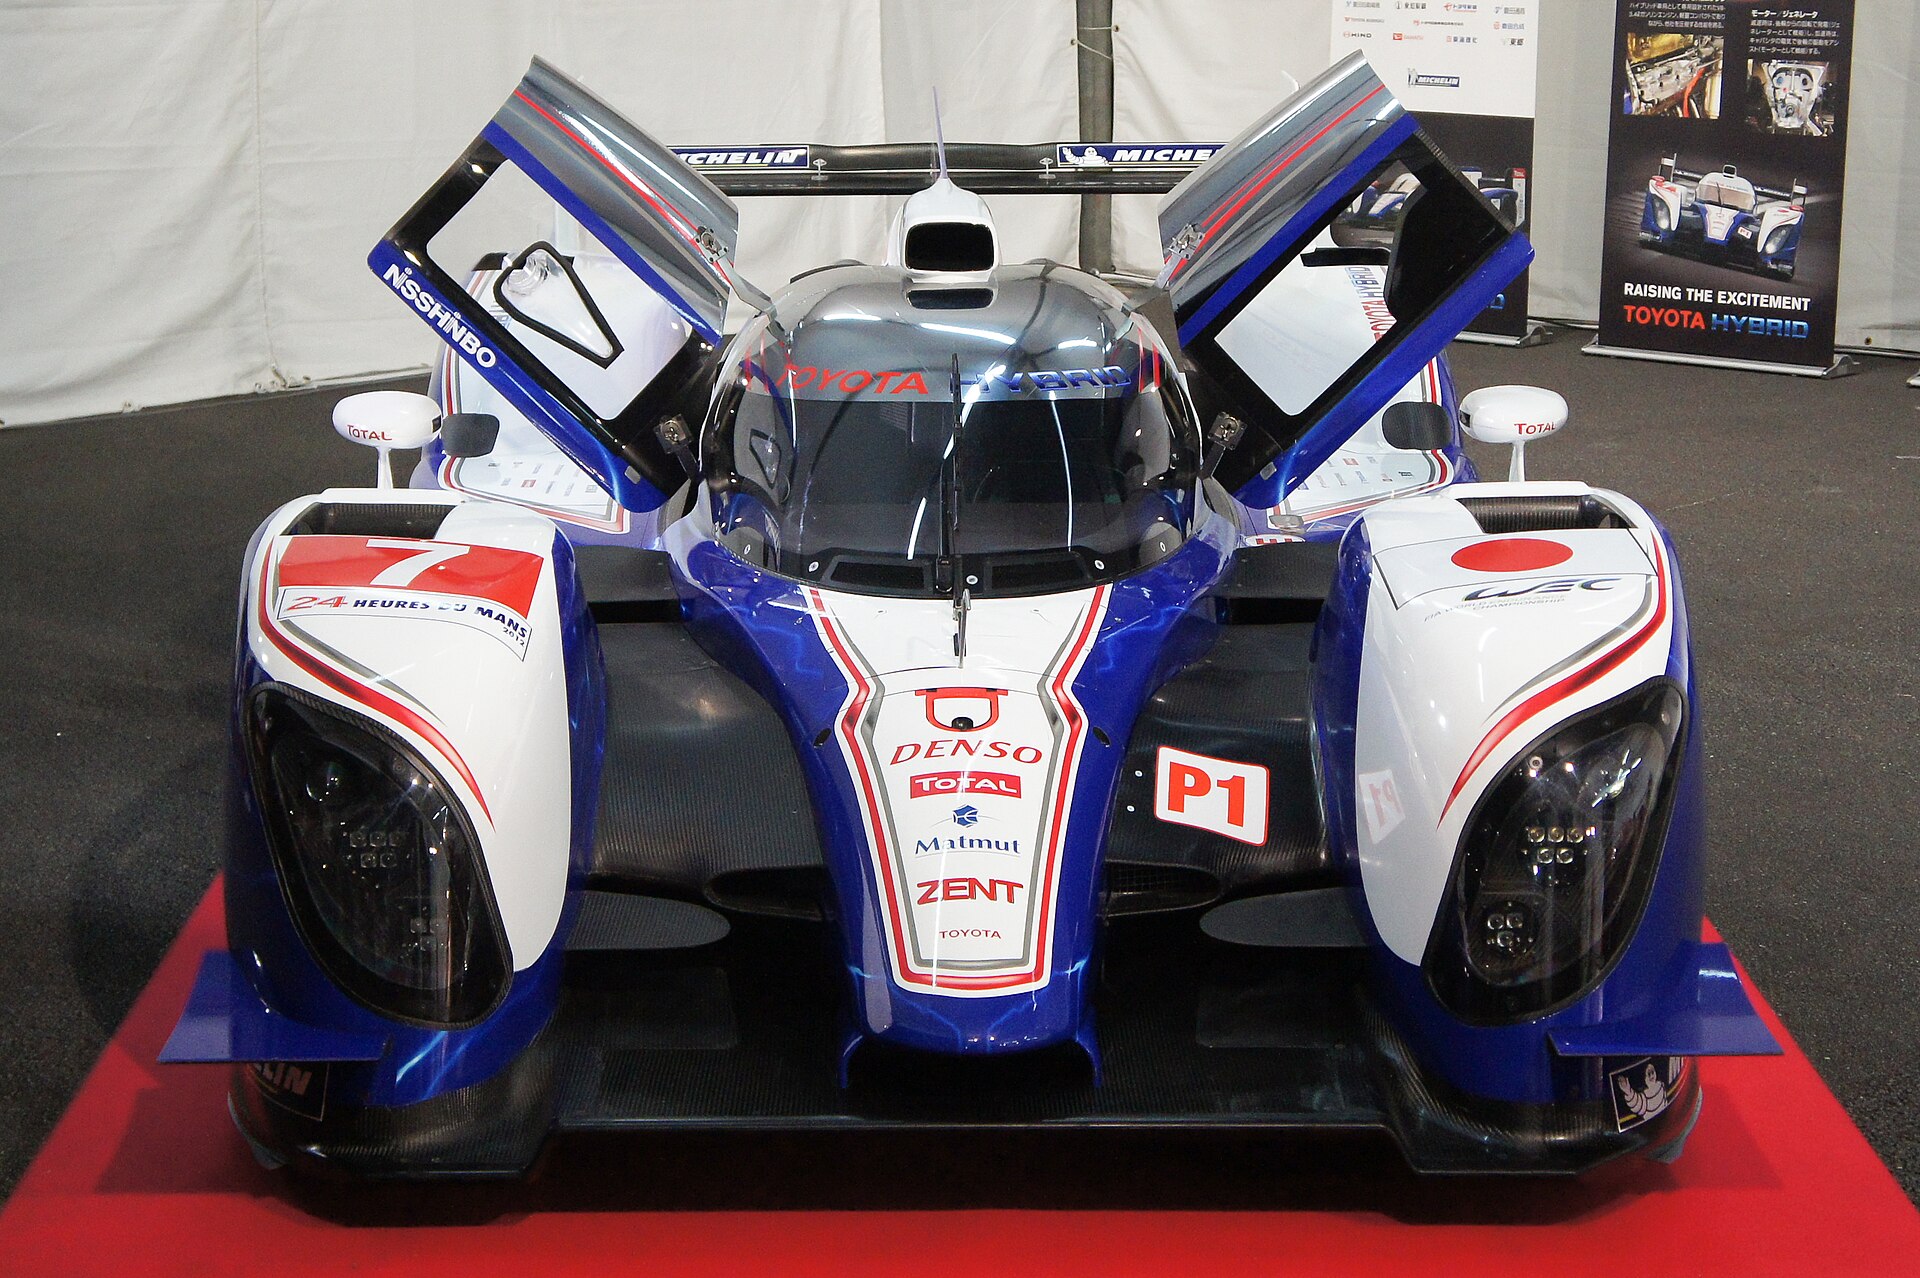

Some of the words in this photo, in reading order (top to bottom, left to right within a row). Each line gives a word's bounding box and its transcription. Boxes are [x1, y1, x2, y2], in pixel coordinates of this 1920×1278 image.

[1418, 76, 1459, 86] MICHELIN
[1112, 149, 1220, 162] MICHE
[1624, 282, 1682, 300] RAISING
[1686, 288, 1713, 303] THE
[1717, 290, 1811, 311] EXCITEMENT
[1623, 304, 1706, 330] TOYOTA
[1711, 313, 1809, 339] HYBRID
[776, 362, 929, 395] TOYOTA
[347, 424, 392, 441] TOTAL
[1514, 421, 1556, 435] TOTAL
[366, 538, 471, 587] 7
[1463, 578, 1622, 602] WEC
[284, 596, 348, 612] 24
[353, 599, 430, 610] HEURES
[475, 606, 528, 638] MANS
[503, 626, 525, 647] 2012
[890, 739, 1042, 766] DENSO
[915, 777, 1018, 794] TOTAL
[1168, 761, 1246, 828] P1
[915, 835, 1021, 855] Matmut
[916, 877, 1023, 905] ZENT
[939, 929, 1001, 939] TOYOTA
